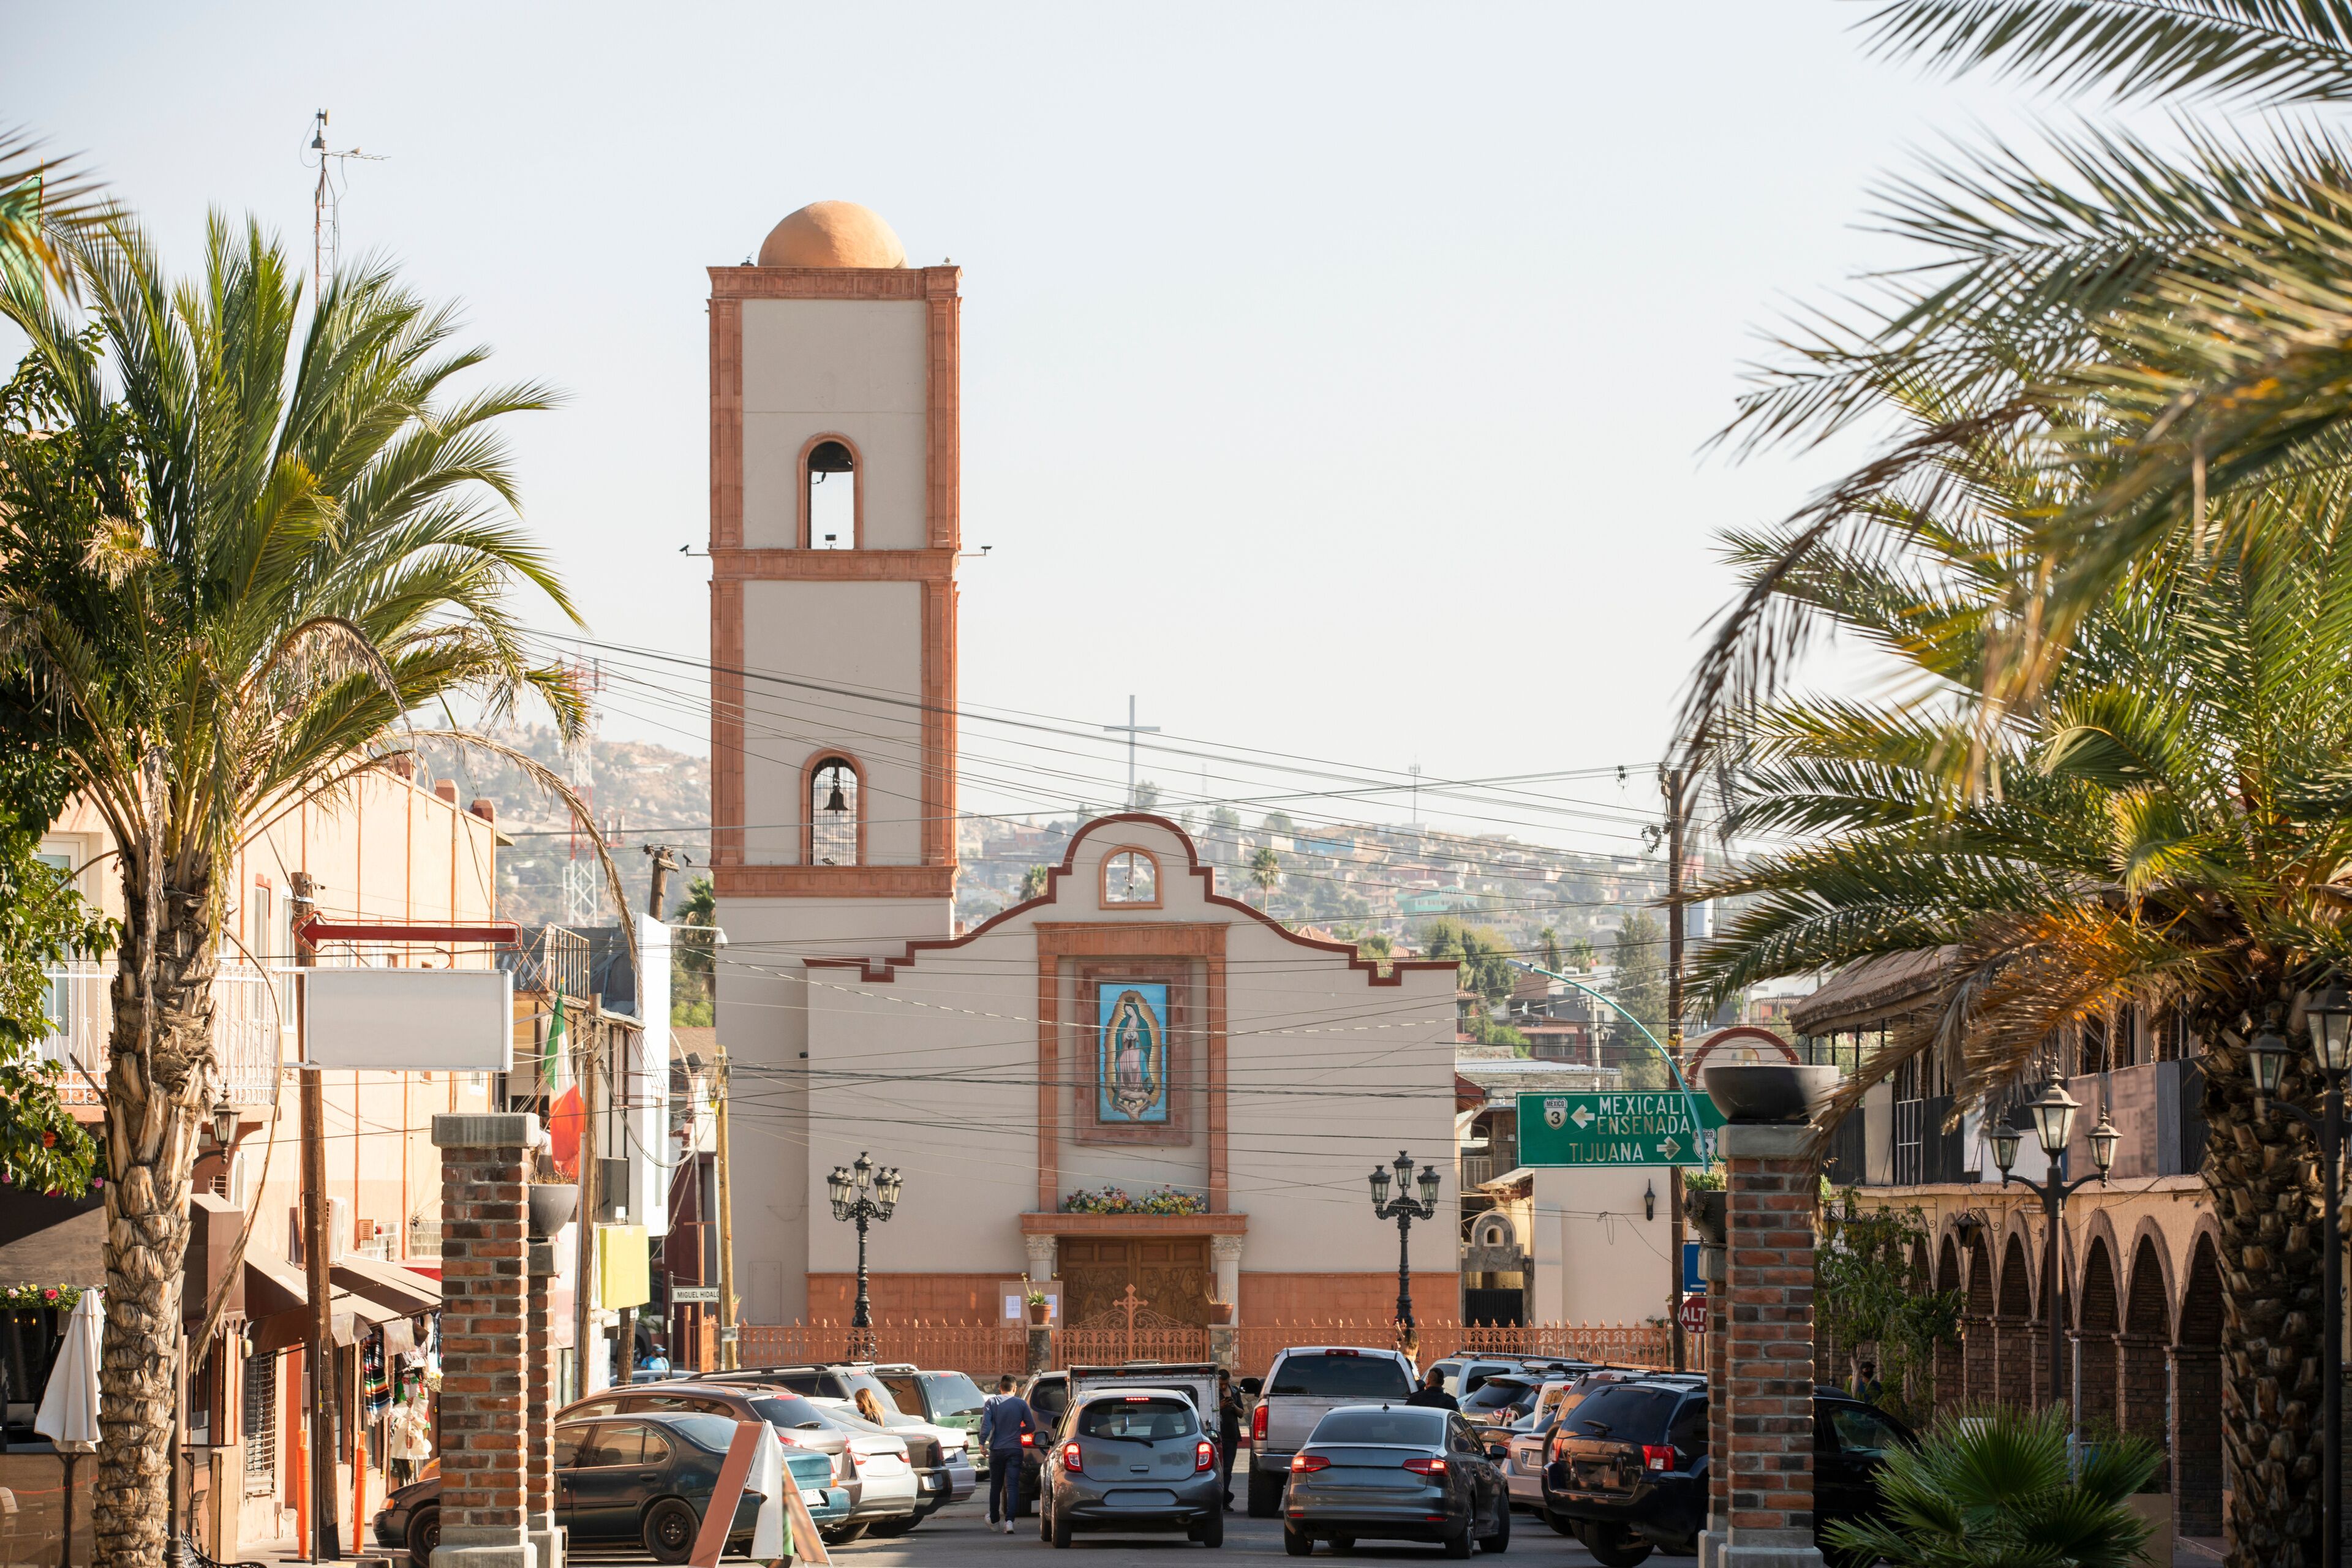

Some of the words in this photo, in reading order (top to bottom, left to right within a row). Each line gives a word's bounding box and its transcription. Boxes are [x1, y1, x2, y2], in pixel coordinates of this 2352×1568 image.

[1599, 1096, 1686, 1115] MEXICALI
[1551, 1111, 1561, 1125] 3
[1597, 1115, 1691, 1135] ENSENADA
[1569, 1142, 1644, 1162] TIJUANA
[1681, 1307, 1706, 1322] ALT
